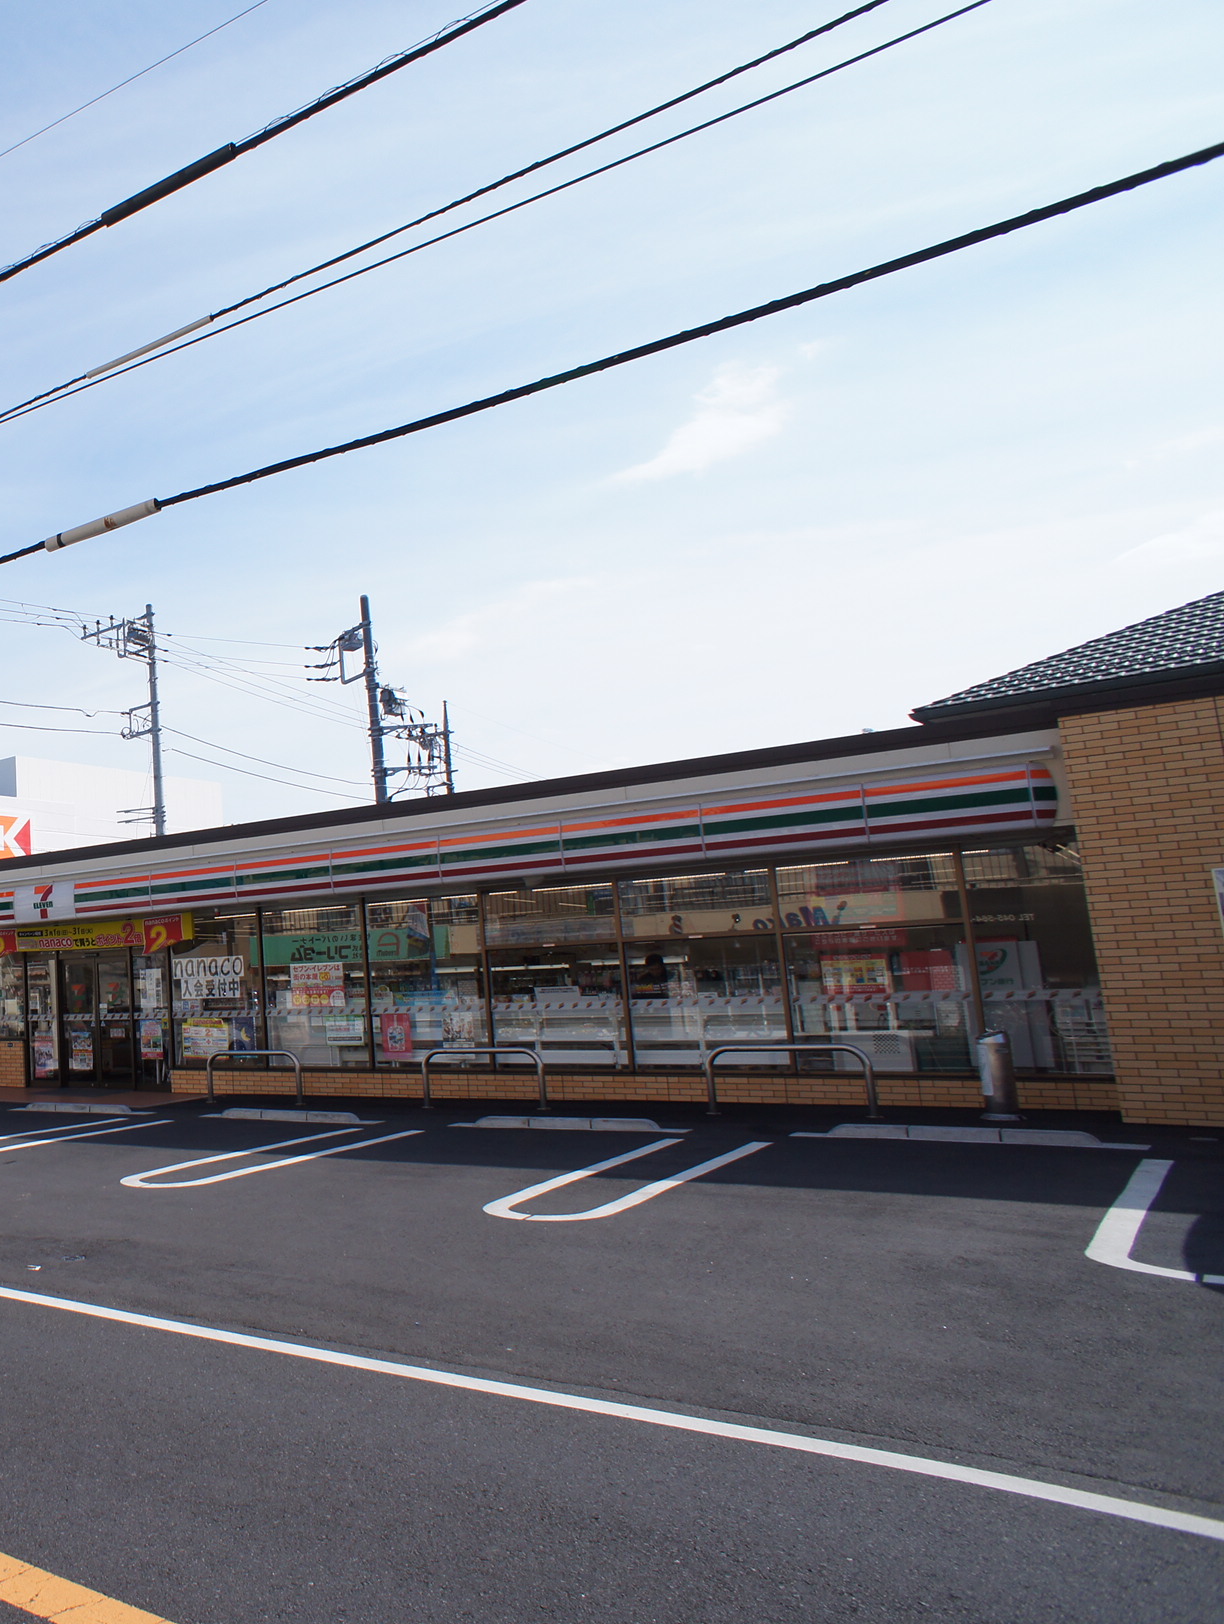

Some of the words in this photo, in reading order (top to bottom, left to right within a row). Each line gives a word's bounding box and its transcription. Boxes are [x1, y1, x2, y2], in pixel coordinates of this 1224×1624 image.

[173, 957, 243, 978] nanaco
[182, 978, 239, 997] 入会受付中
